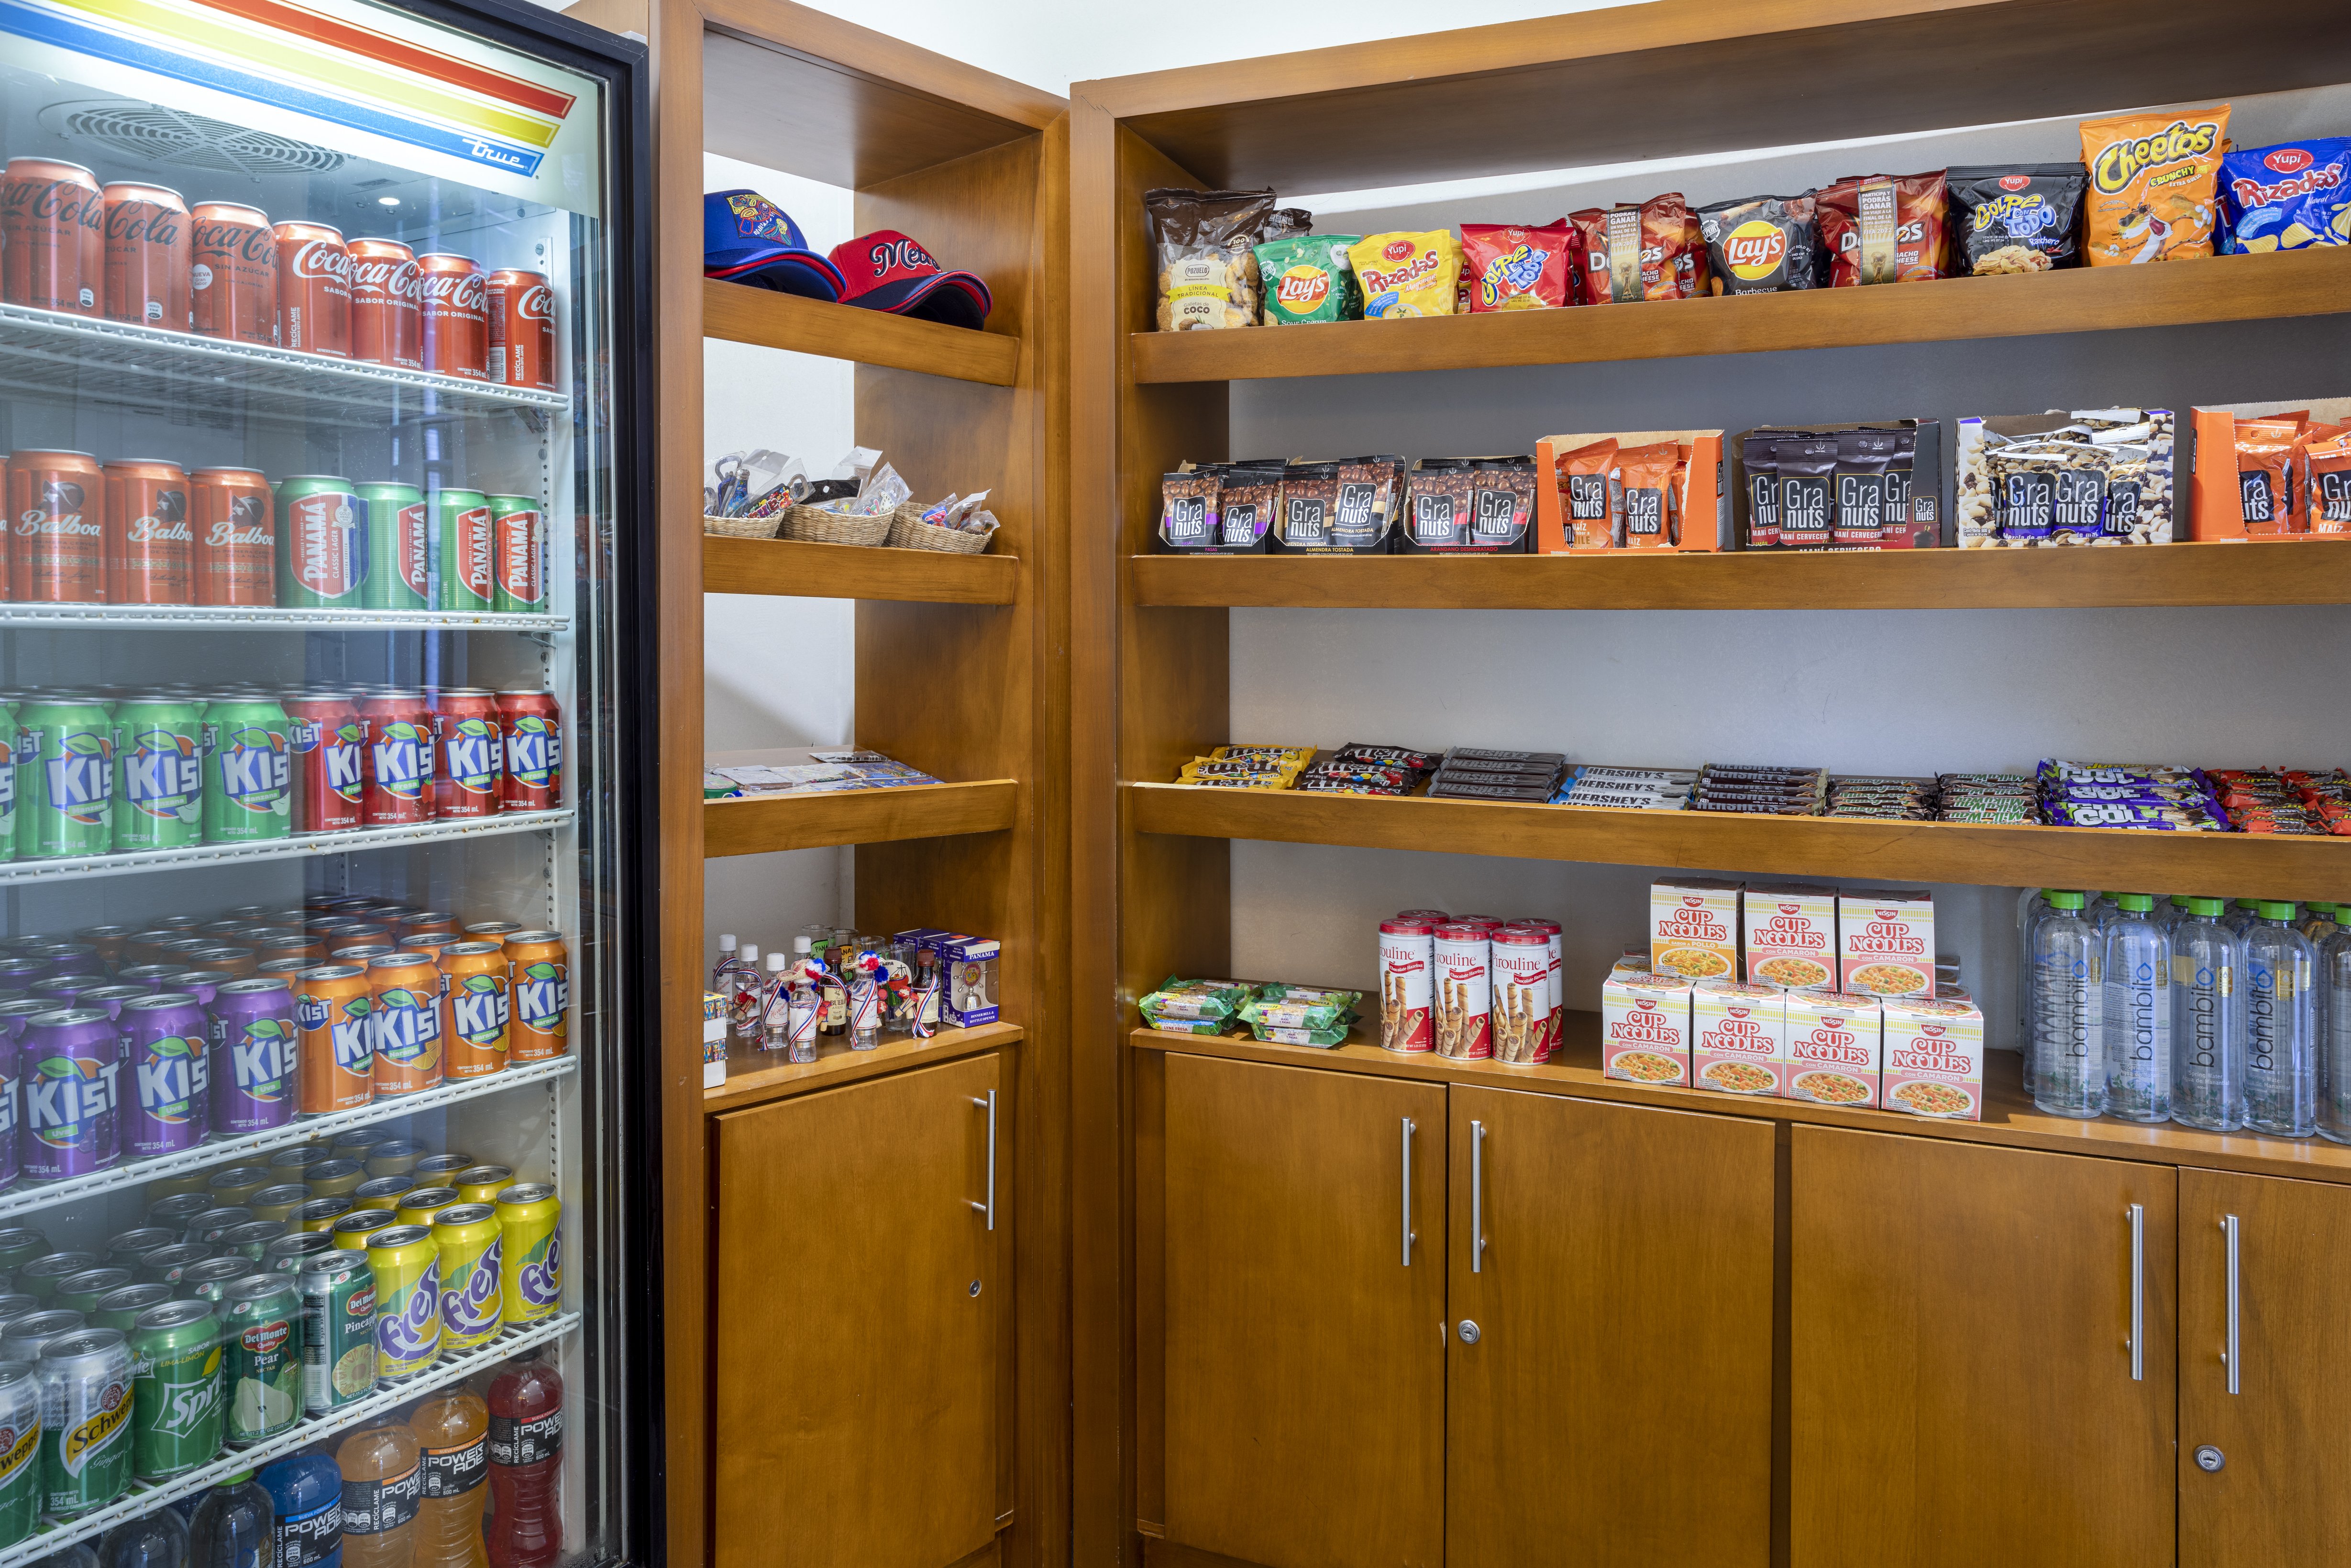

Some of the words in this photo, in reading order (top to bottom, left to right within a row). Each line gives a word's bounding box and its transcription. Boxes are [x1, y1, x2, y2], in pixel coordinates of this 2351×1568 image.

[2097, 123, 2214, 192] Cheetos
[2273, 154, 2302, 165] Yupi
[2005, 177, 2023, 186] Yupi
[2150, 165, 2196, 186] CRUNCHY
[2186, 174, 2202, 184] QUESO
[1611, 216, 1636, 224] GANAR
[2029, 237, 2060, 245] Ranchero
[1387, 243, 1407, 254] Yupi
[1728, 232, 1782, 267] Lay's
[236, 265, 269, 277] AZÚCAR
[1187, 266, 1208, 275] POZUELO
[1280, 274, 1326, 302] Lay's
[1735, 286, 1778, 296] Barbecue
[451, 312, 484, 322] ORIGINAL
[1787, 480, 1824, 509] Gra
[1176, 500, 1202, 521] Gra
[1916, 498, 1934, 512] Gra
[15, 509, 101, 536] Balboa
[1787, 506, 1824, 528] nuts
[1916, 510, 1934, 521] nuts
[205, 521, 275, 547] Balboa
[1175, 520, 1202, 536] nuts
[300, 503, 328, 582] PANAMÁ
[468, 514, 486, 587] PANAMÁ
[506, 520, 528, 590] PANAMÁ
[1459, 749, 1531, 758] HERSHEY'S
[524, 772, 546, 780] Fresa
[1588, 768, 1665, 779] HERSHEY'S
[243, 792, 277, 803] Manzana
[1684, 897, 1702, 905] NISSIN
[1675, 909, 1712, 926] CUP
[1659, 920, 1727, 941] NOODLES
[969, 951, 994, 960] PANAMA
[1627, 1011, 1666, 1028] CUP
[2189, 967, 2214, 1068] bambito
[1611, 1022, 1679, 1045] NOODLES
[389, 1046, 419, 1058] Naranja
[1633, 1042, 1670, 1051] CAMARÓN
[2188, 1071, 2206, 1079] Spring
[52, 1128, 70, 1137] Uva
[244, 1334, 259, 1344] Del
[260, 1326, 287, 1341] Monte
[188, 1341, 210, 1354] SABOR
[257, 1340, 276, 1349] Quality
[160, 1351, 204, 1368] LIMA-LIMÓN
[254, 1352, 279, 1367] Pear
[255, 1365, 276, 1374] NECTAR
[72, 1391, 134, 1454] Schwepp
[455, 1441, 472, 1451] FÓRMULA
[89, 1450, 123, 1470] Ginger
[428, 1442, 484, 1467] POWER
[453, 1455, 484, 1475] ADE
